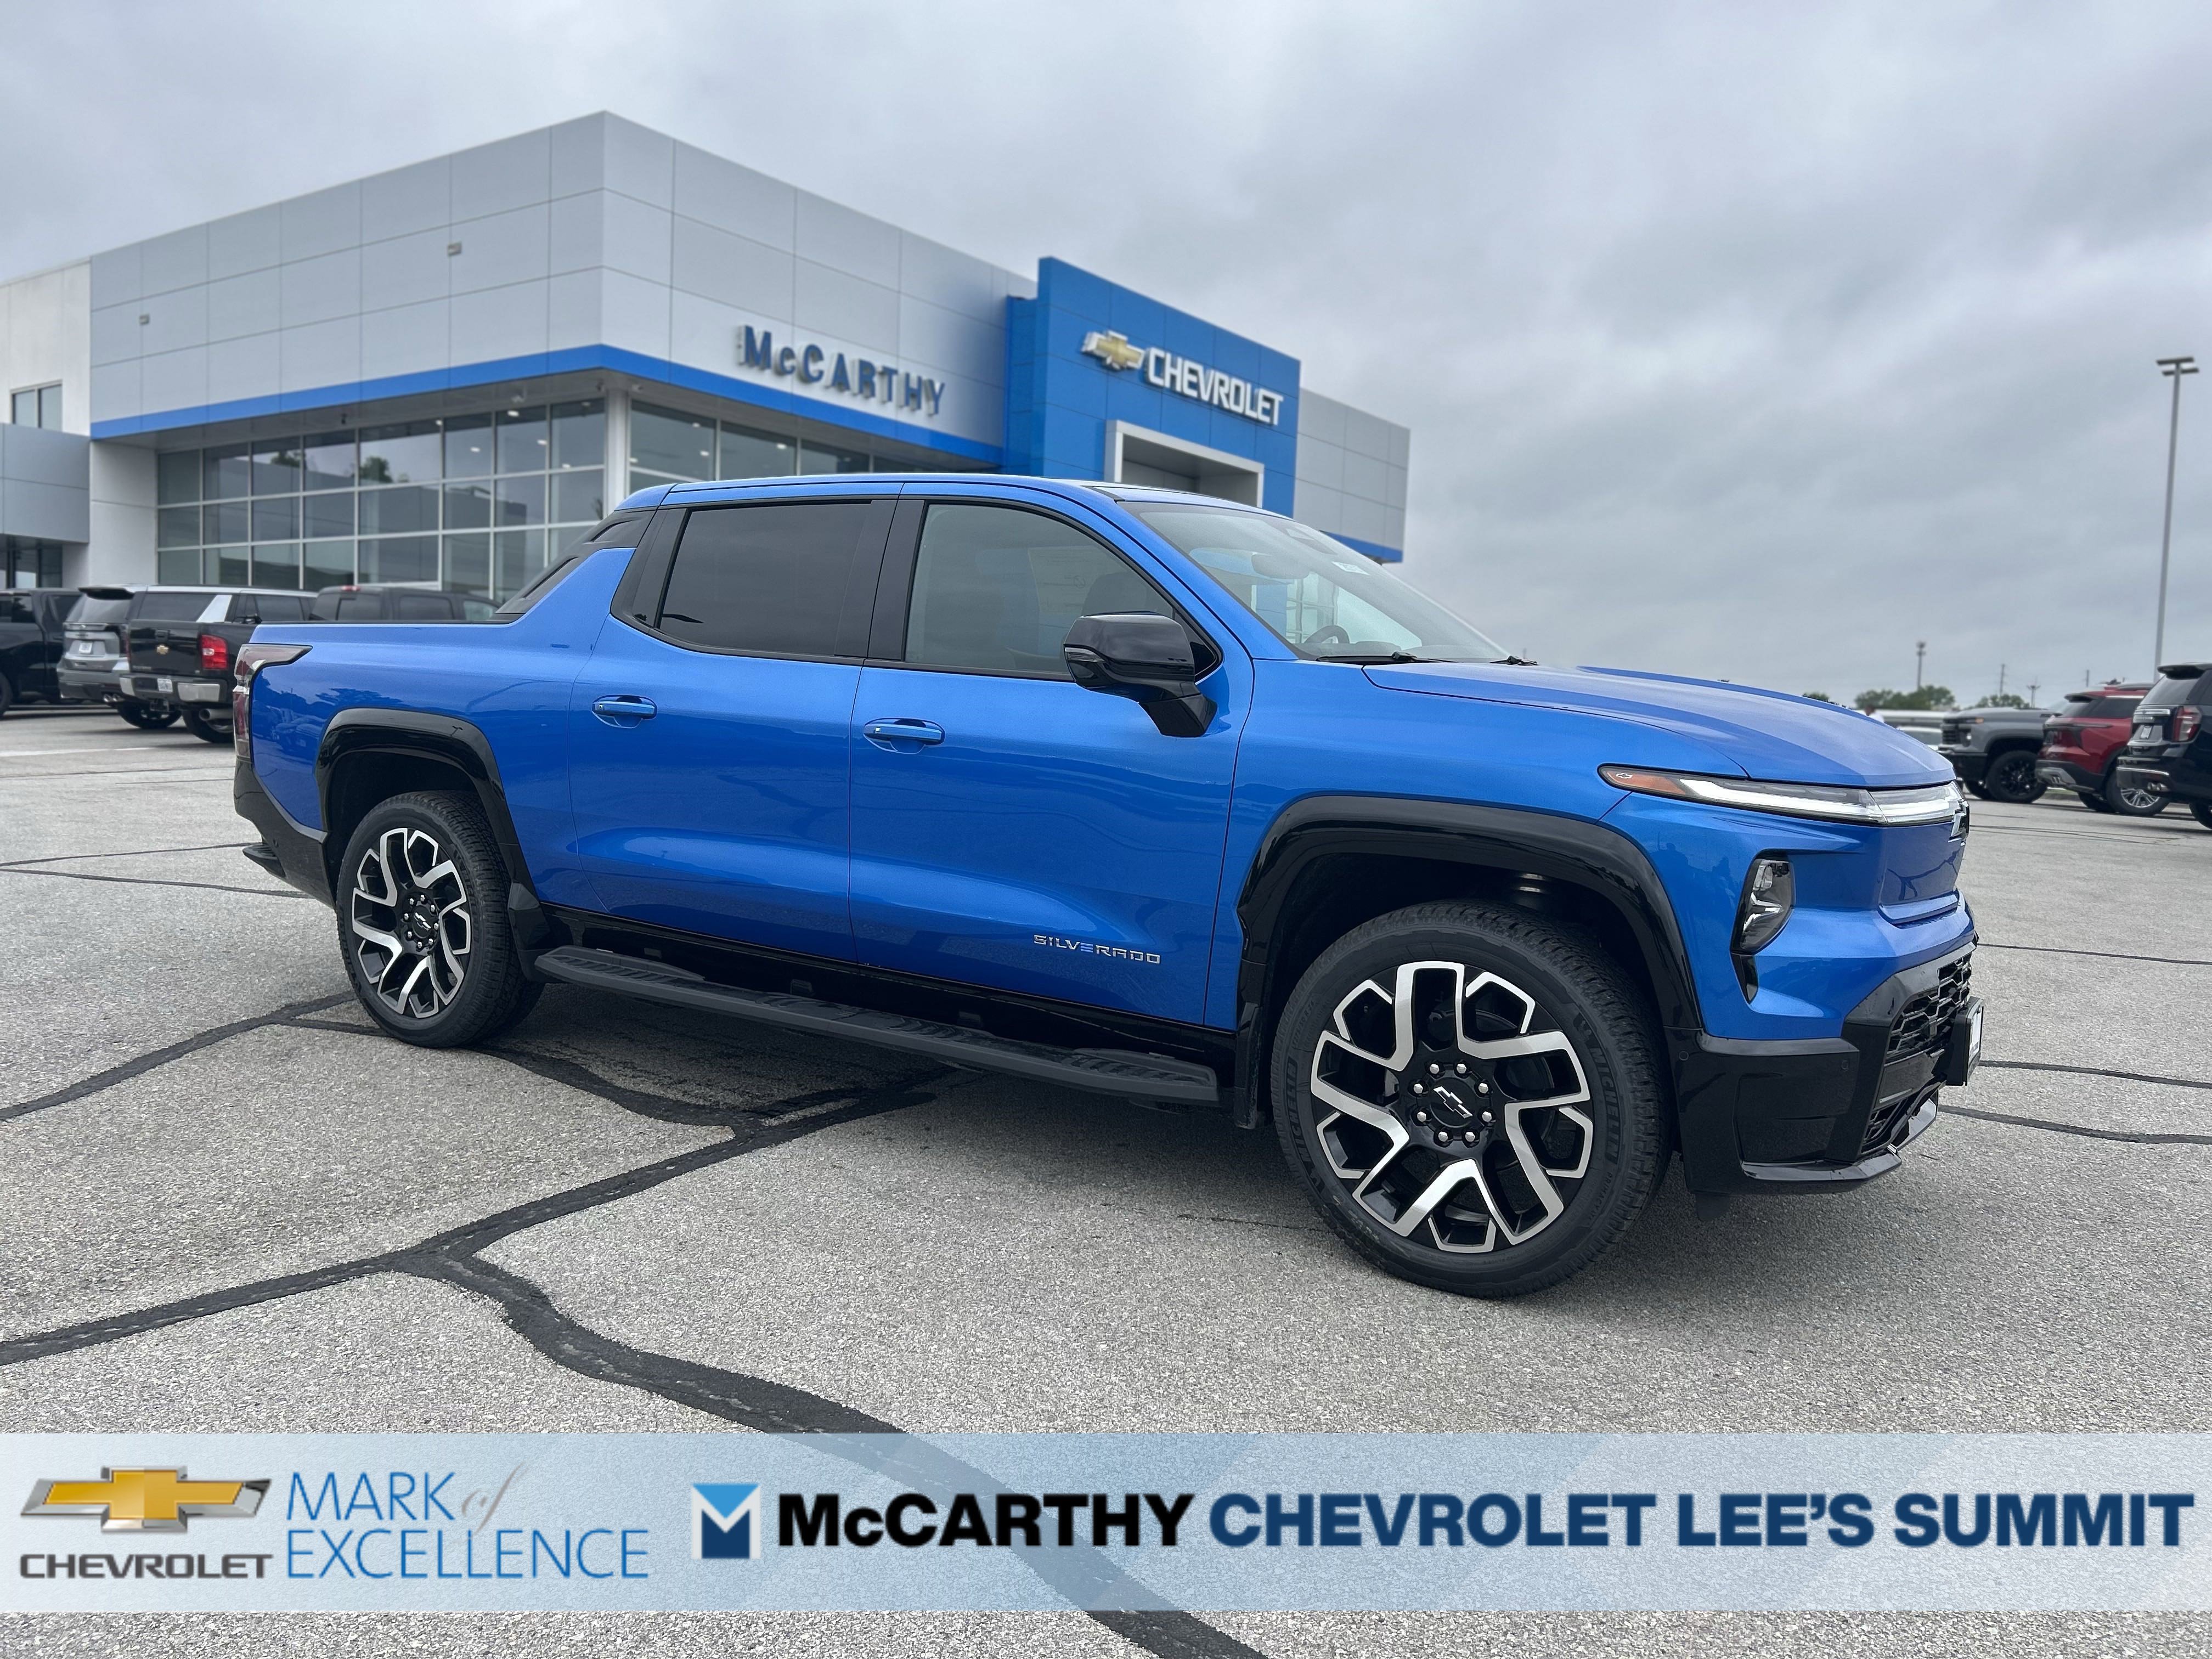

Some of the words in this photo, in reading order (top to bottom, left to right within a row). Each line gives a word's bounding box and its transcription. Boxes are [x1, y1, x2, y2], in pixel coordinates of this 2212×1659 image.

[738, 325, 945, 415] McCARTHY
[1146, 347, 1284, 426] CHEVROLET
[1034, 934, 1160, 964] SILVERADO
[1287, 1060, 1312, 1163] MICHELIN
[1590, 1047, 1619, 1159] MICHELIN
